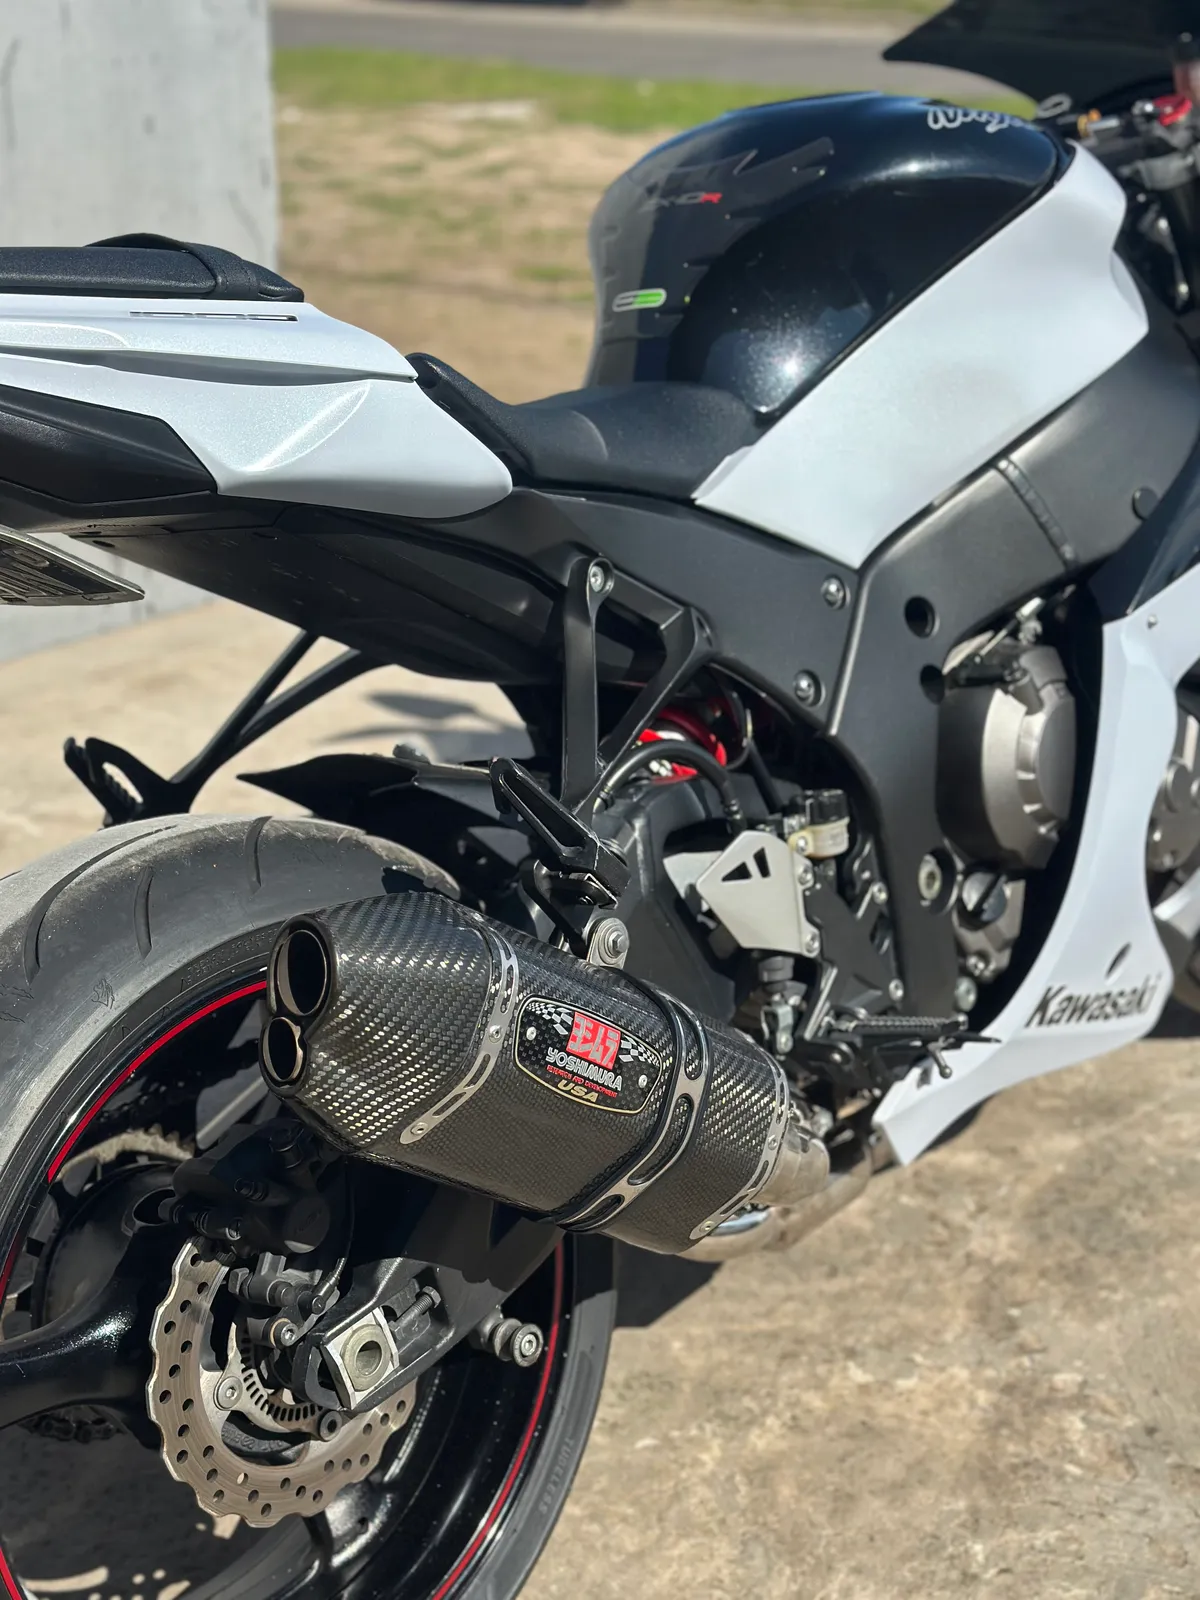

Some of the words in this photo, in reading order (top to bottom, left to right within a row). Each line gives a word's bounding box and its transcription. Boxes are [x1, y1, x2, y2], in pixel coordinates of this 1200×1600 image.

[1024, 972, 1162, 1028] Kawasaki
[545, 1047, 622, 1091] YOSHIMURA
[557, 1080, 599, 1103] USA
[572, 1075, 585, 1085] AND
[585, 1080, 617, 1098] DEVELOPMENT
